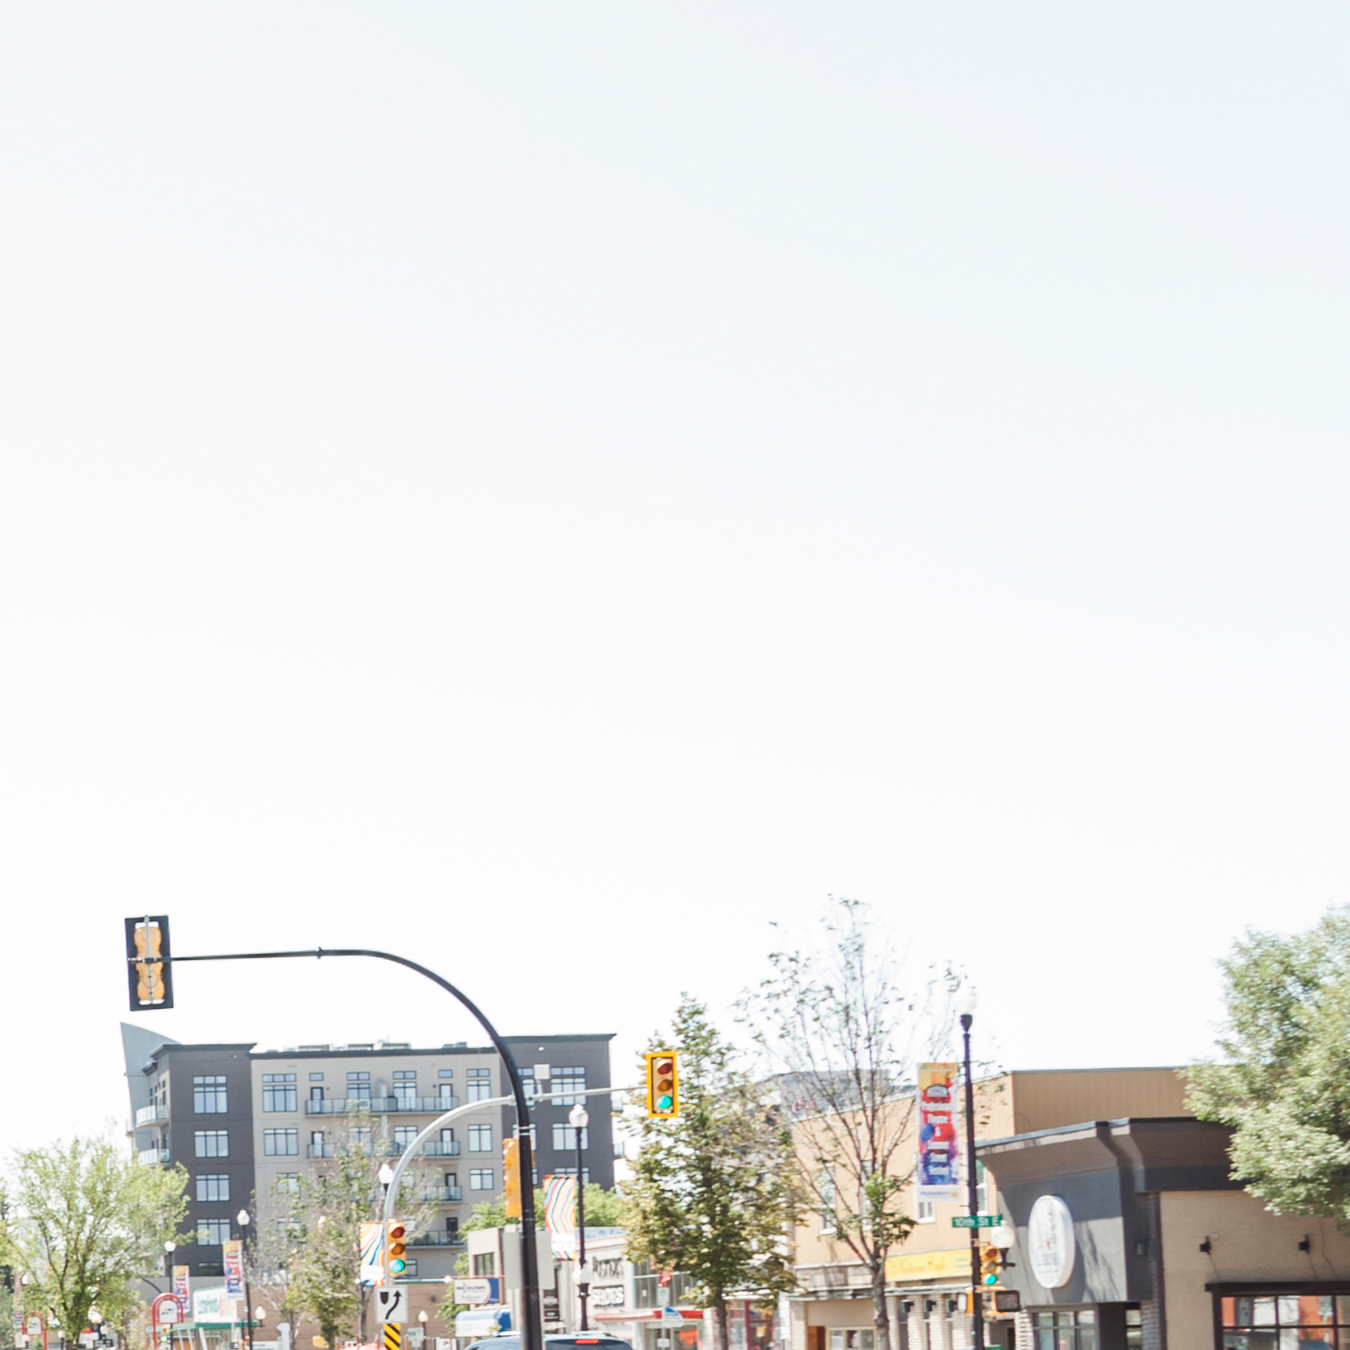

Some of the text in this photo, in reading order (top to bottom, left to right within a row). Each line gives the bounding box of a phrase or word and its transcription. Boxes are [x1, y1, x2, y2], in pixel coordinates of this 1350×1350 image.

[954, 1216, 1001, 1227] 10th St E
